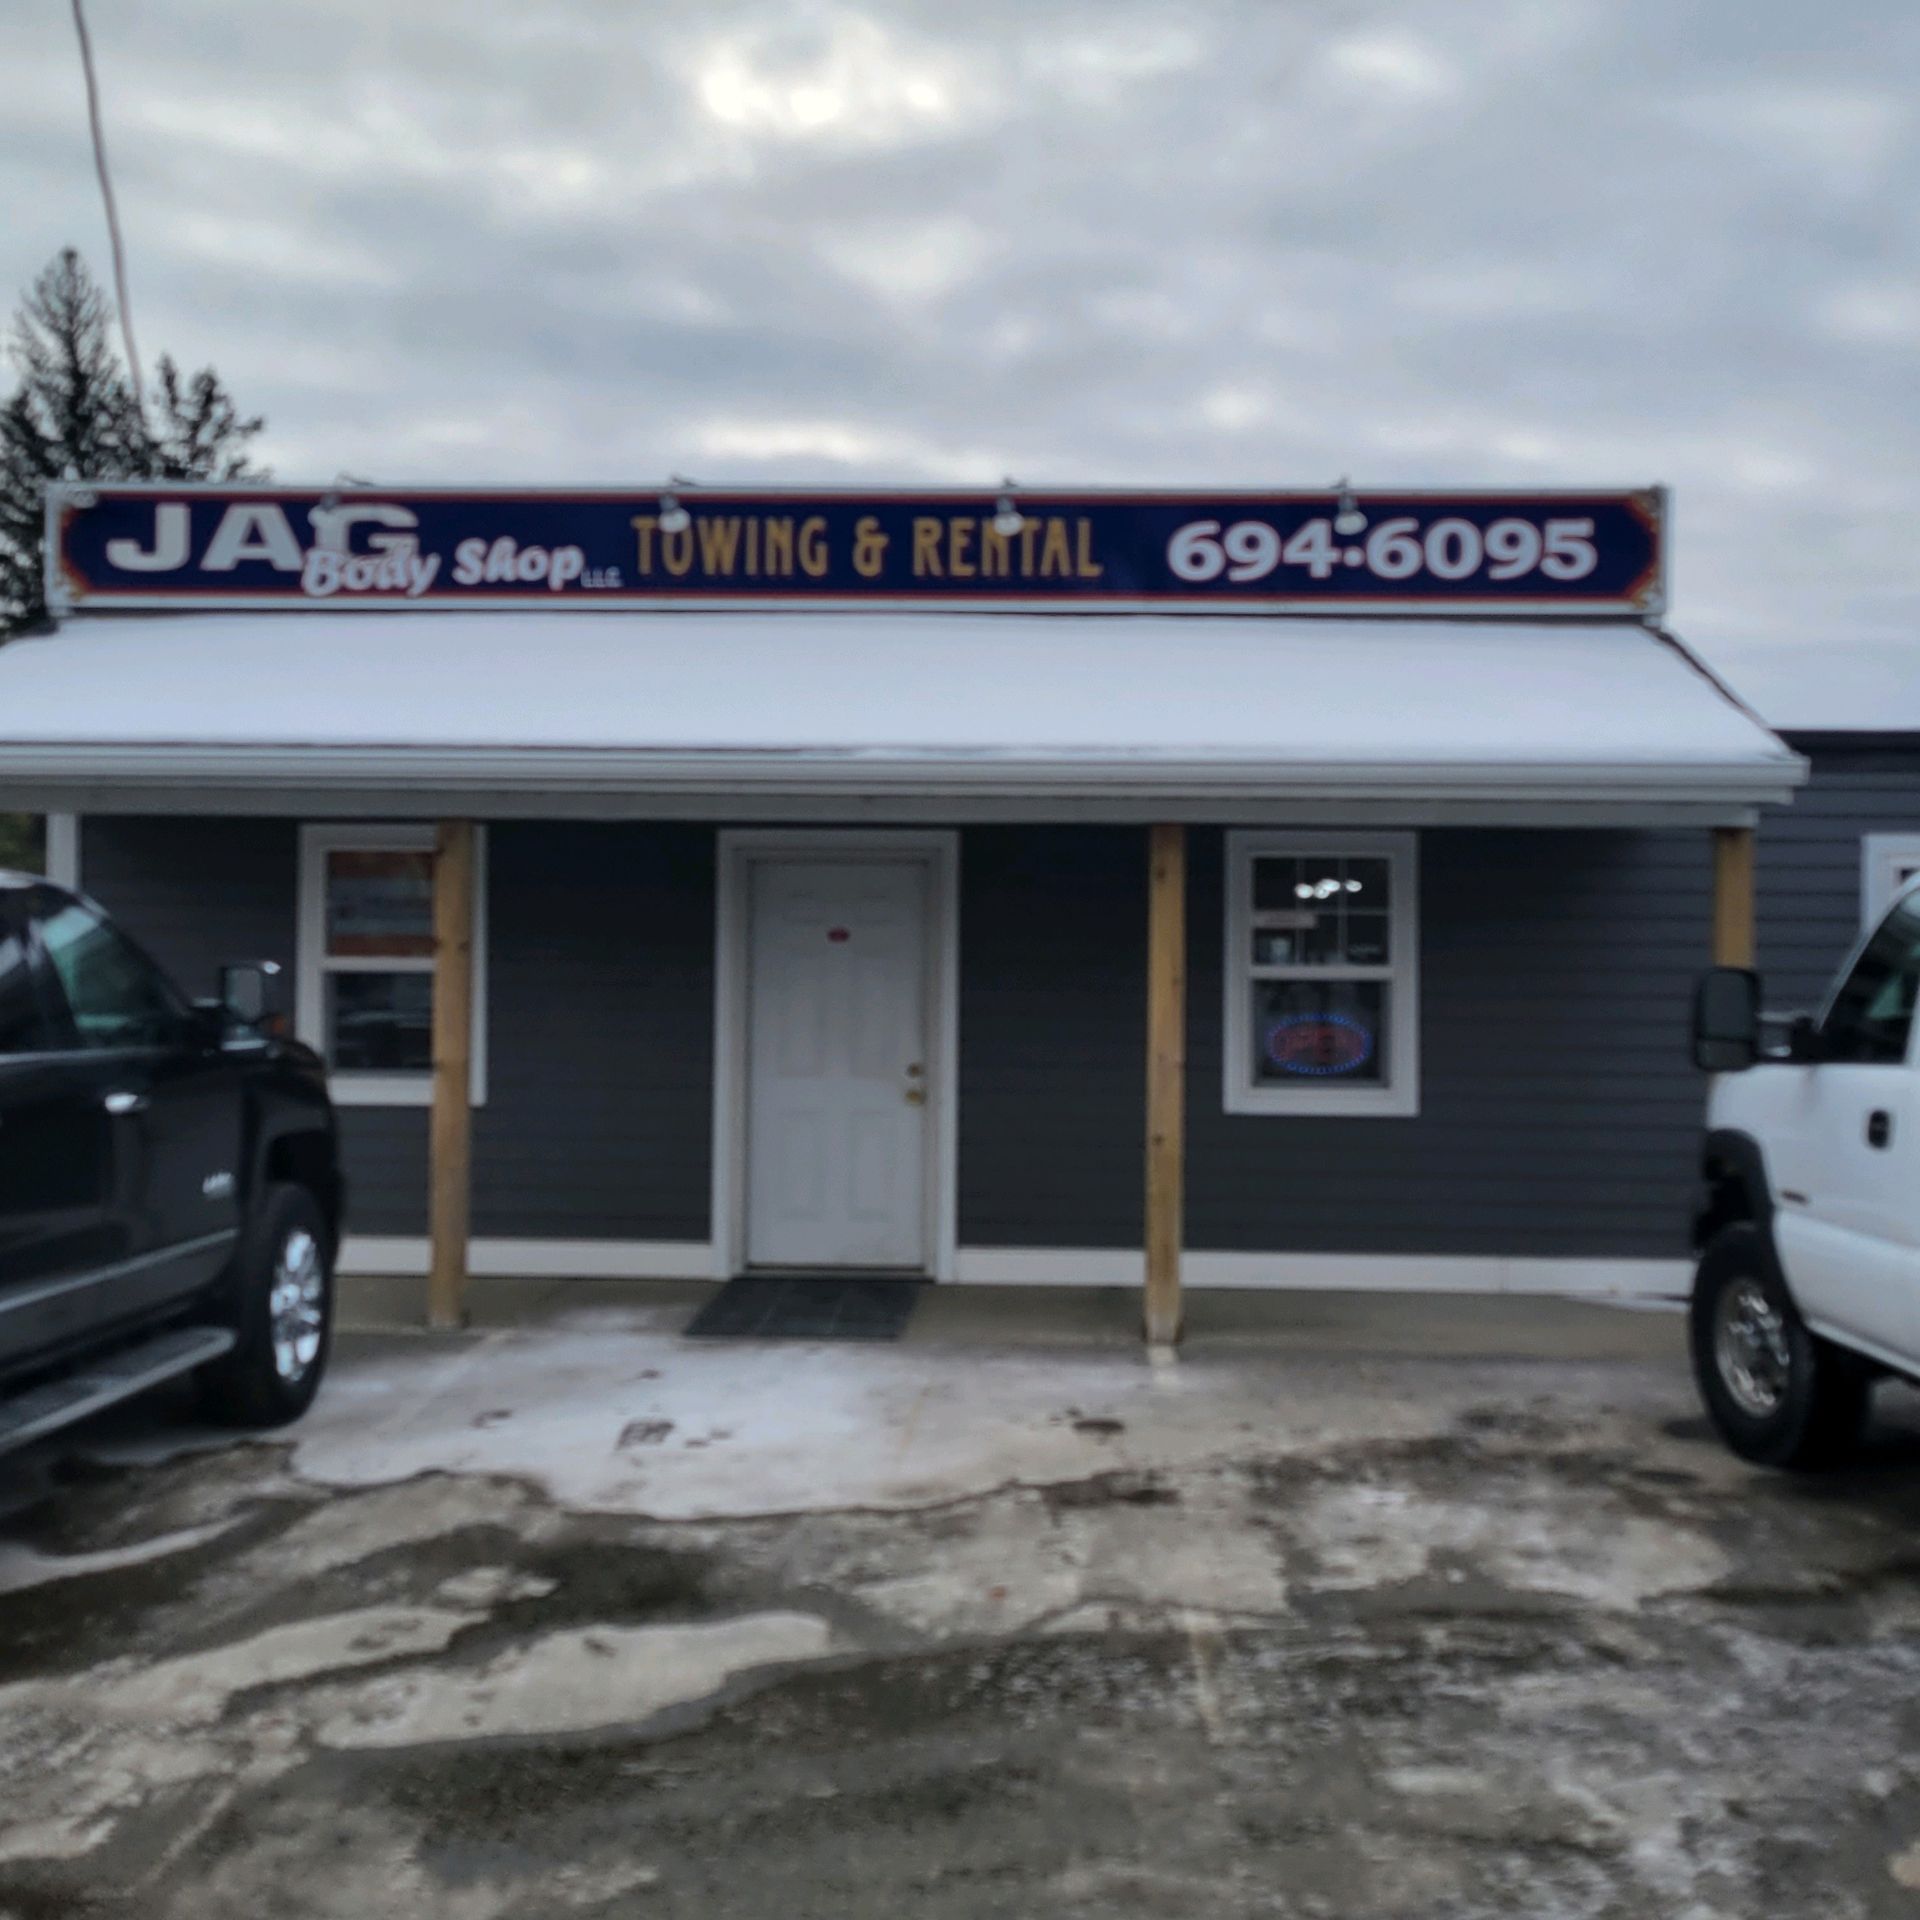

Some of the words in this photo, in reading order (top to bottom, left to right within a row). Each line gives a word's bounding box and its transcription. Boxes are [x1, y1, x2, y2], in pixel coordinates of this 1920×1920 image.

[106, 502, 420, 572] JAG
[301, 546, 442, 598] Body
[452, 536, 585, 591] Shop
[630, 516, 829, 578] TOWING
[852, 516, 890, 578] &
[912, 517, 1103, 578] RENTAL
